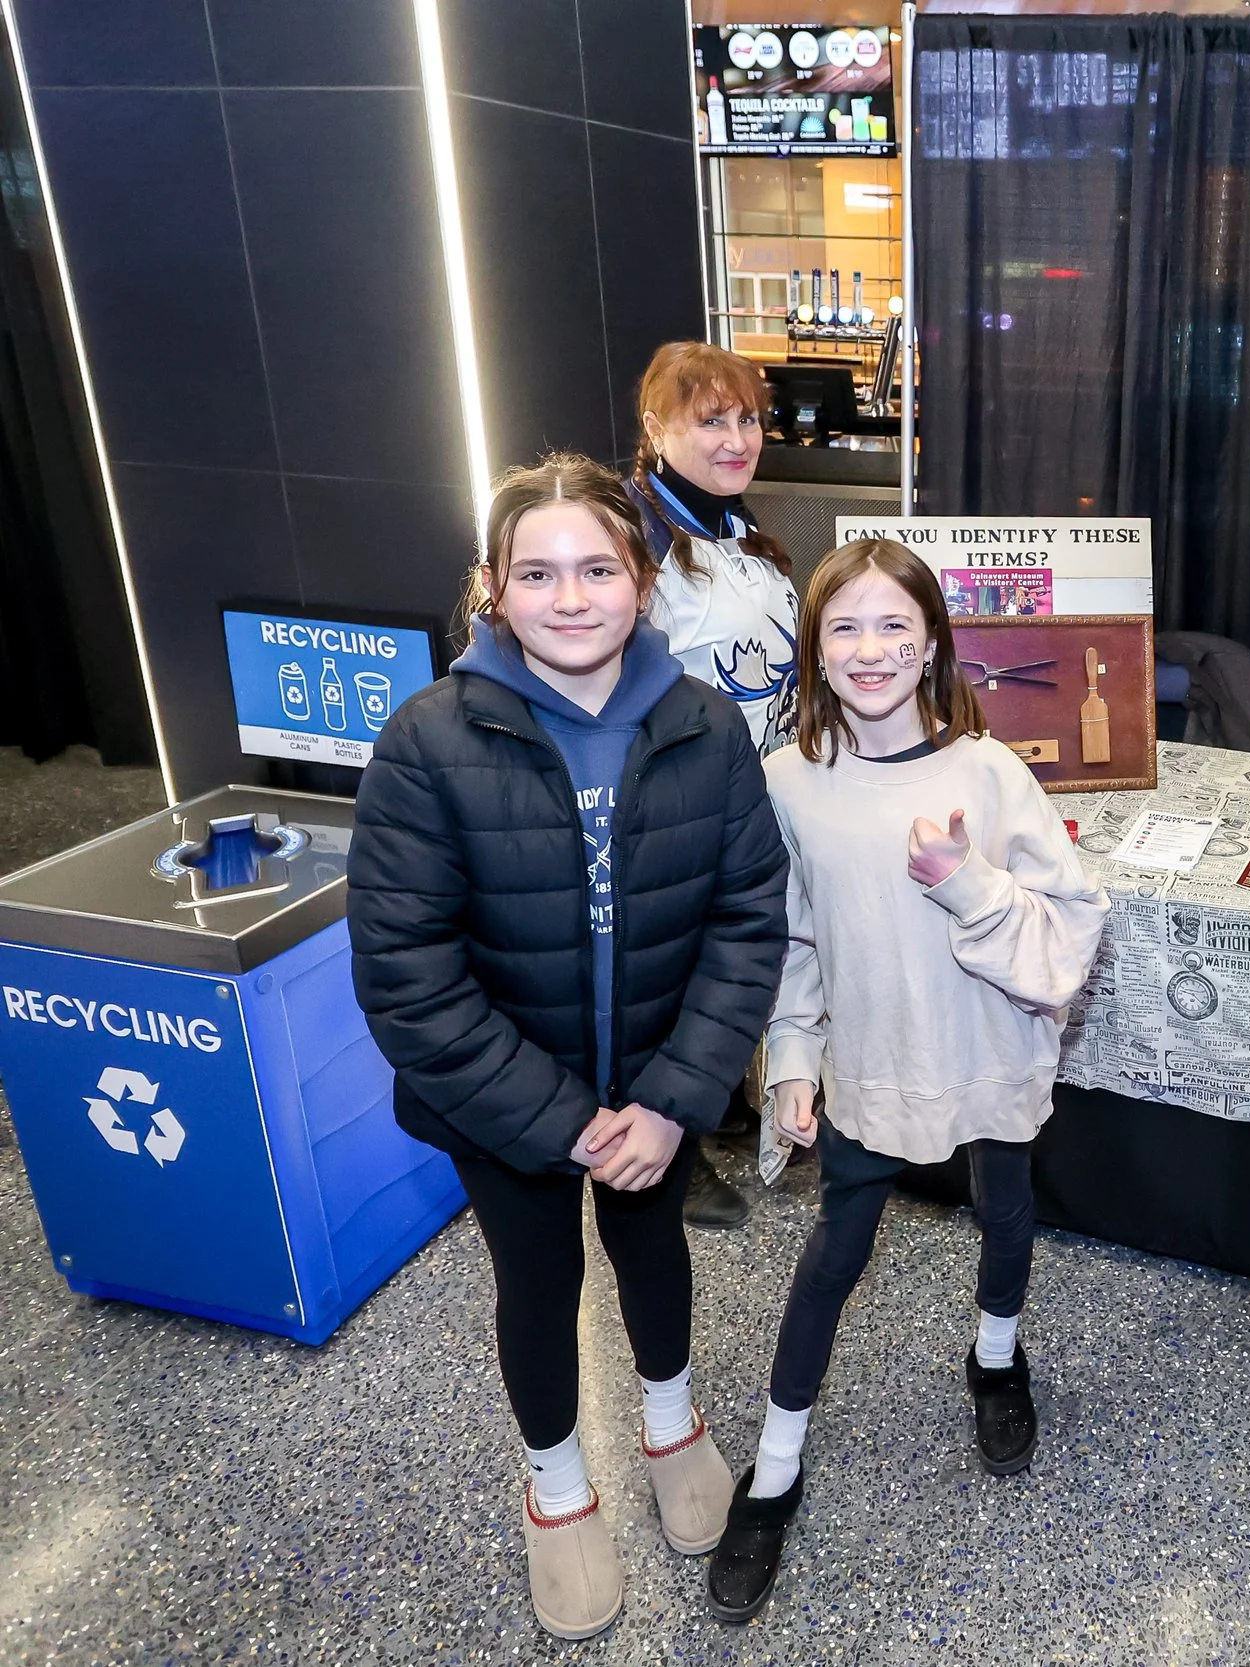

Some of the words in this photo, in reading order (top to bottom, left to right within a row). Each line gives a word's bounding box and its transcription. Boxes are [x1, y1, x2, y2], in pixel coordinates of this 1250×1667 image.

[729, 98, 771, 113] TEQUILA
[771, 98, 825, 112] COCKTAILS
[845, 529, 886, 543] CAN
[896, 529, 938, 543] YOU
[951, 529, 1057, 544] IDENTIFY
[1069, 528, 1140, 543] THESE
[966, 552, 1049, 567] ITEMS?
[260, 620, 398, 659] RECYCLING
[279, 732, 319, 744] ALUMINUM
[289, 743, 311, 752] CANS
[333, 740, 361, 751] PLASTIC
[335, 749, 363, 760] BOTTLES
[1125, 900, 1159, 915] Journal
[2, 986, 222, 1053] RECYCLING
[1134, 1024, 1163, 1034] illustré
[1205, 1040, 1238, 1050] Journal
[1219, 1069, 1250, 1079] PIANOS
[1183, 1077, 1246, 1091] PANFULLINE
[1168, 1086, 1220, 1104] WATERBURY
